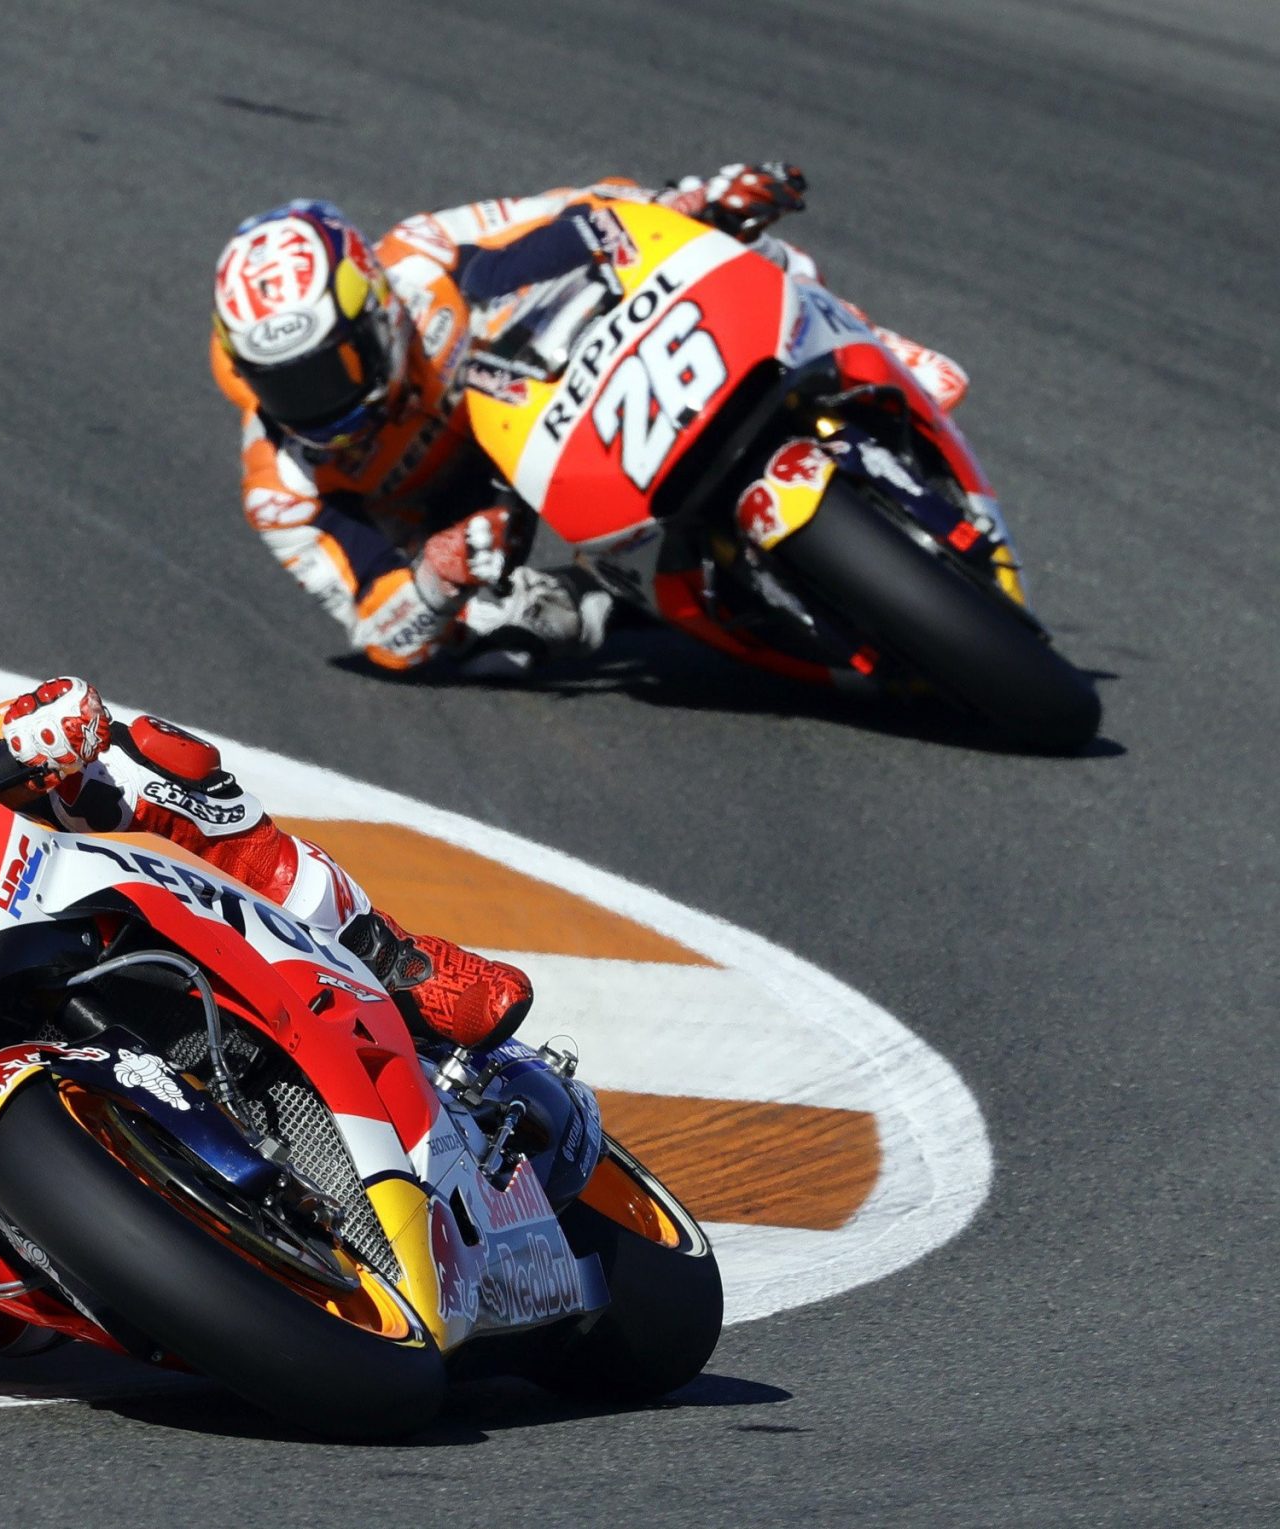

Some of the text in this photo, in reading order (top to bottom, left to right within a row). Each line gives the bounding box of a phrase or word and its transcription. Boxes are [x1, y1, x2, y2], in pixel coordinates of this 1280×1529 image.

[542, 271, 683, 444] REPSOL
[593, 300, 728, 491] 26
[428, 1133, 463, 1157] HONDA
